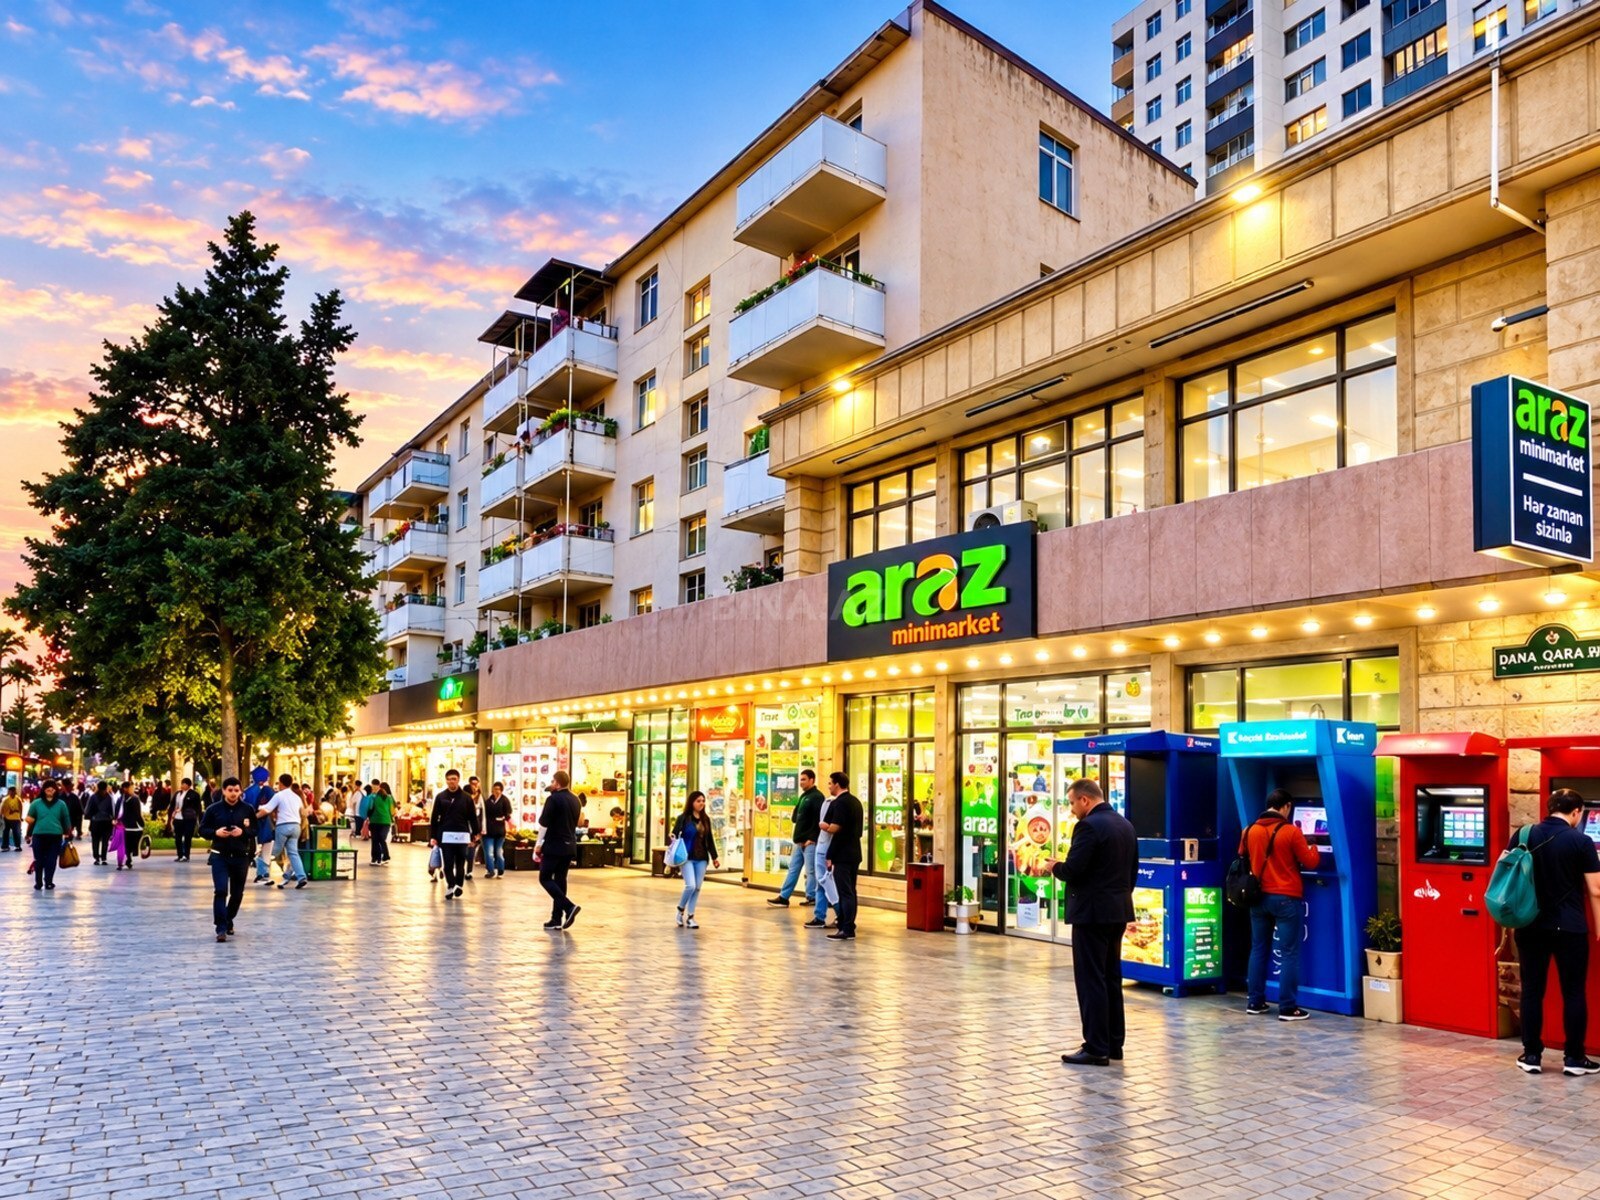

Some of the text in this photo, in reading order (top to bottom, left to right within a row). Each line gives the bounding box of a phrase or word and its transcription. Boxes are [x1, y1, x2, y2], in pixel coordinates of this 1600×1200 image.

[1515, 388, 1586, 449] araz
[1519, 438, 1585, 474] minimarket
[1546, 504, 1583, 527] zaman
[841, 544, 1007, 627] araz
[891, 611, 1001, 646] minimarket
[1499, 651, 1537, 666] DANA
[1542, 647, 1585, 663] QARA
